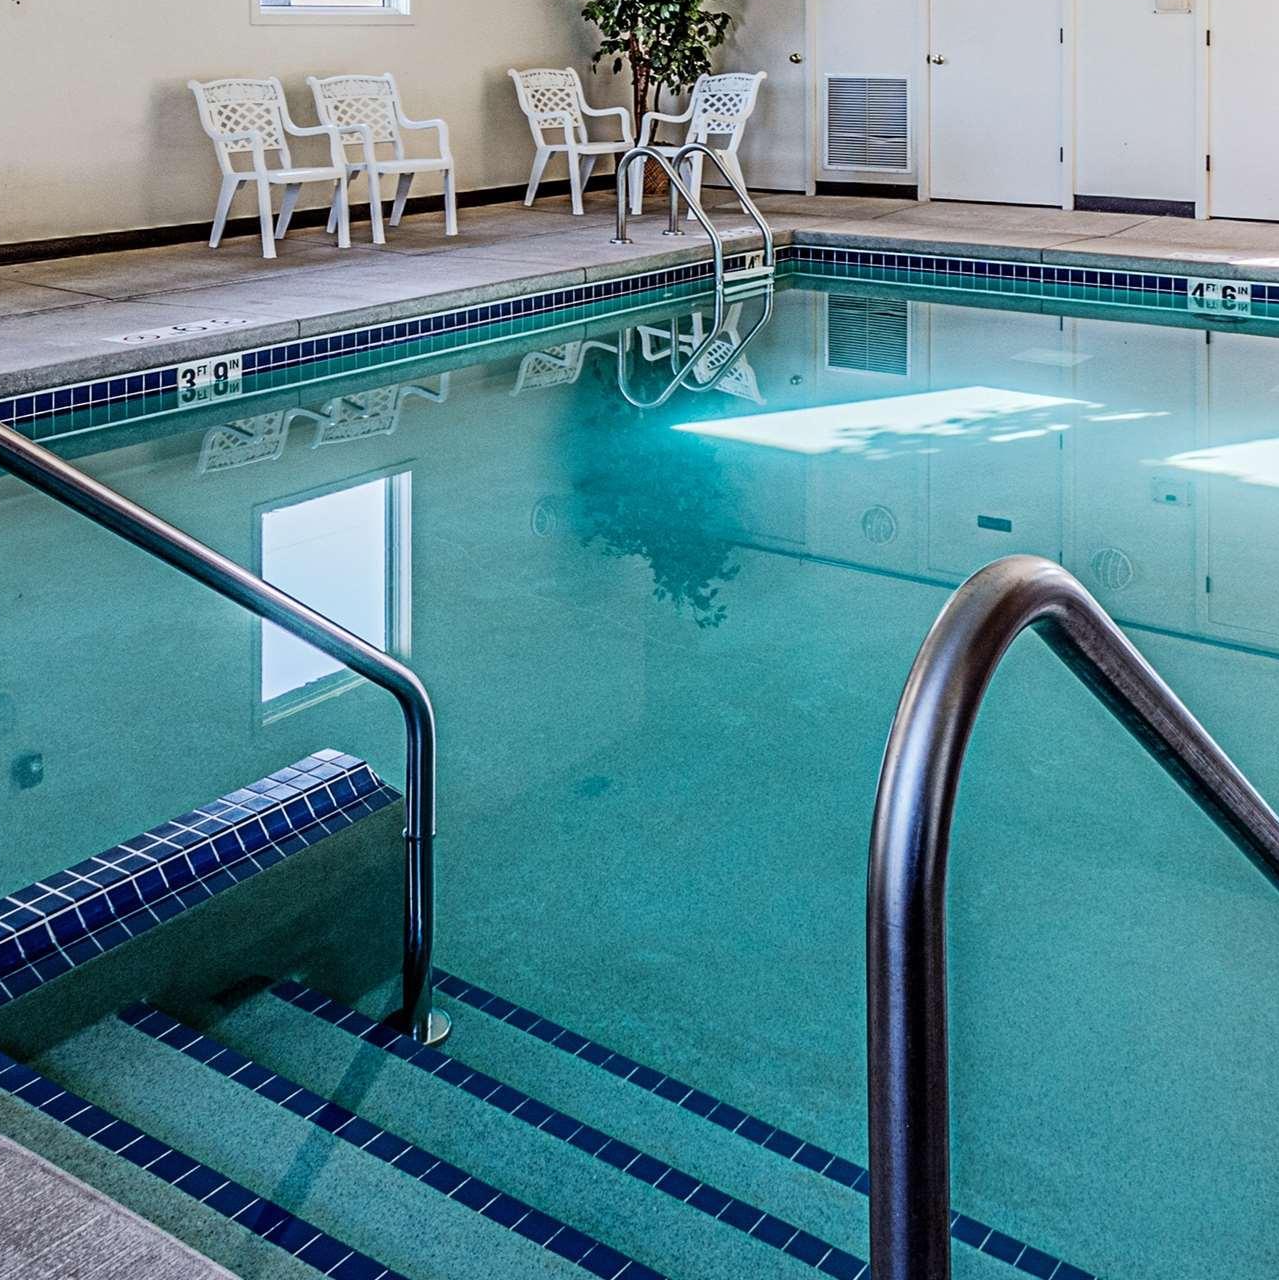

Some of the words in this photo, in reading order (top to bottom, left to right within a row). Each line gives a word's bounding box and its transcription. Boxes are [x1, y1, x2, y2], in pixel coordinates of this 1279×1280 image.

[1191, 282, 1205, 298] 4
[1206, 283, 1217, 292] FT
[1221, 285, 1237, 300] 6
[1237, 286, 1249, 295] IN
[181, 368, 197, 388] 3
[197, 364, 208, 377] FT
[229, 358, 240, 370] IN
